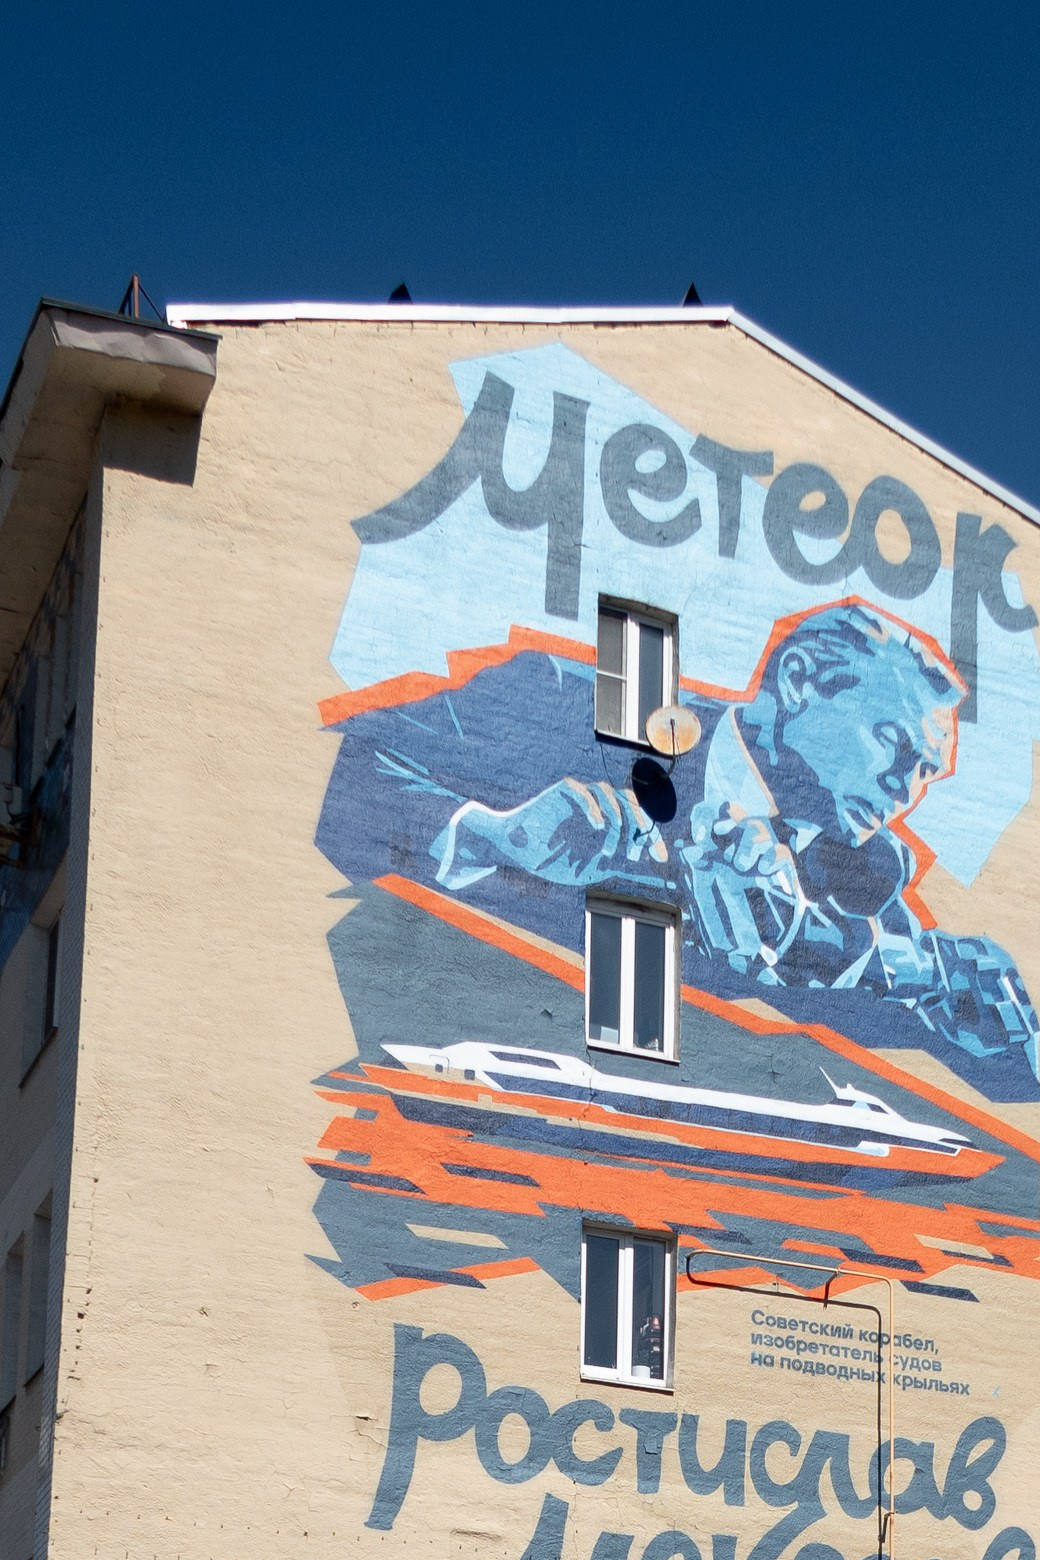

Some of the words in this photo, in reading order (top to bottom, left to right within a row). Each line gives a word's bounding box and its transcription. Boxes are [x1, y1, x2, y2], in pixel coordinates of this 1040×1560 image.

[751, 1309, 853, 1339] Советский
[858, 1328, 940, 1356] корабел,
[751, 1332, 884, 1364] изобретатель
[751, 1351, 775, 1368] на
[780, 1355, 886, 1384] подводных
[893, 1373, 970, 1396] крыльях
[365, 1322, 1006, 1530] Ростислав
